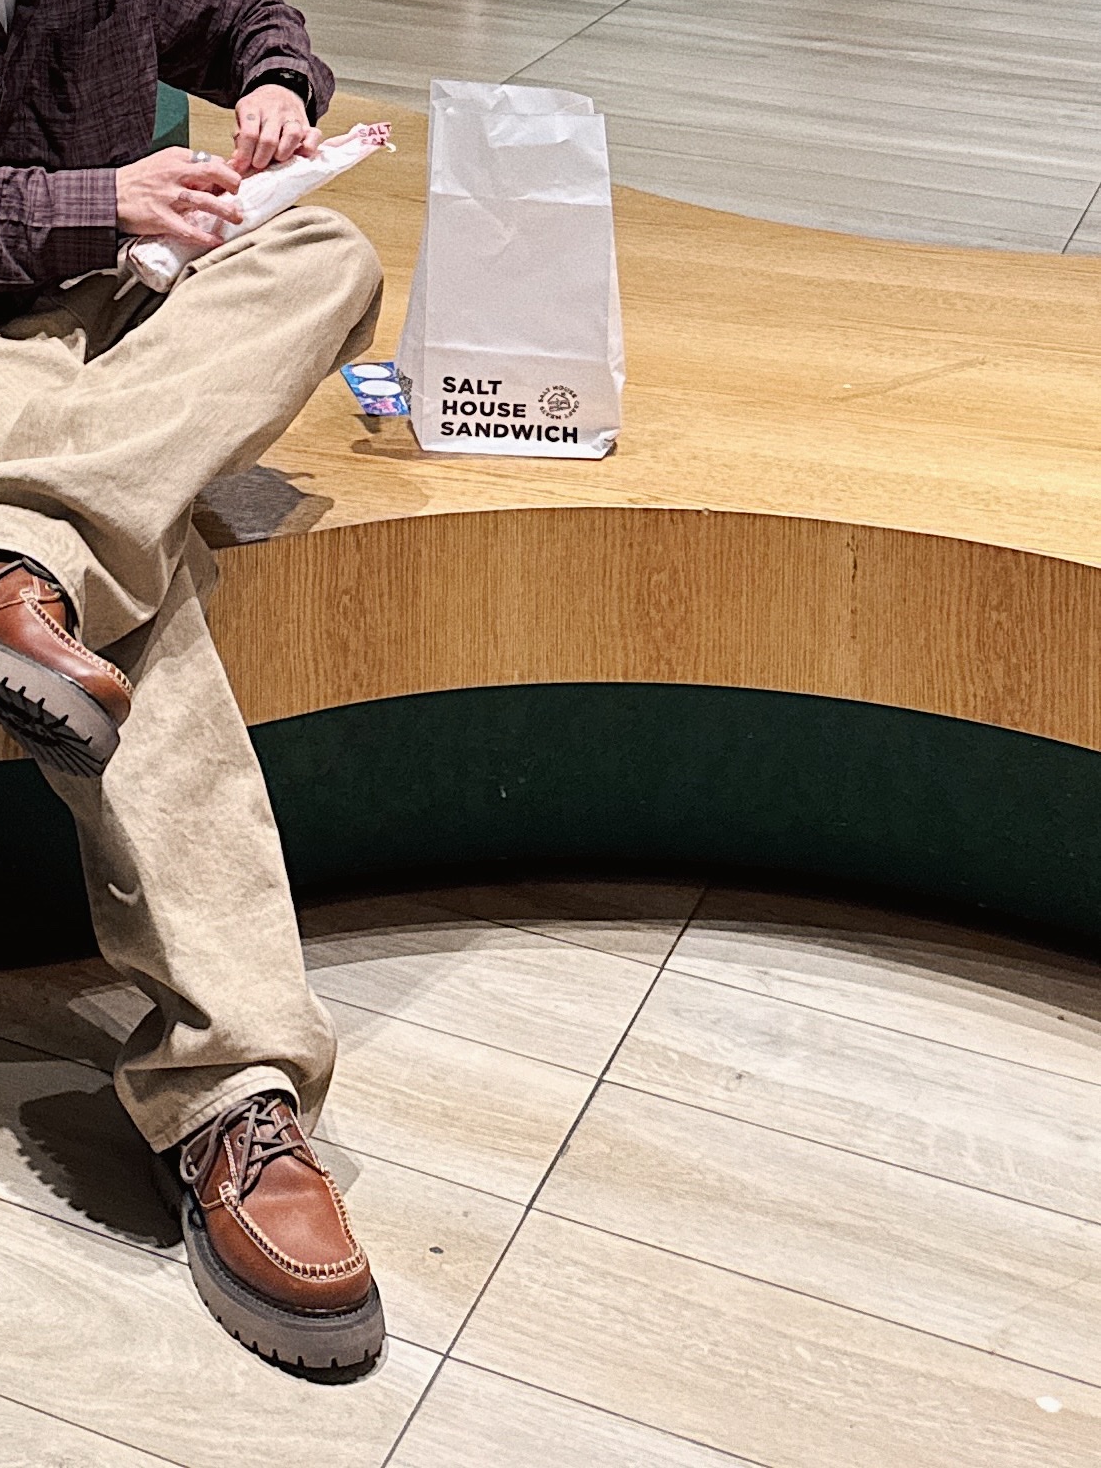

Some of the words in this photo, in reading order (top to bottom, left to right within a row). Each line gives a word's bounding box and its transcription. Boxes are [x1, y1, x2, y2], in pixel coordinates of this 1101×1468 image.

[358, 124, 391, 137] SALT
[442, 376, 503, 395] SALT
[442, 400, 527, 418] HOUSE
[440, 421, 578, 444] SANDWICH
